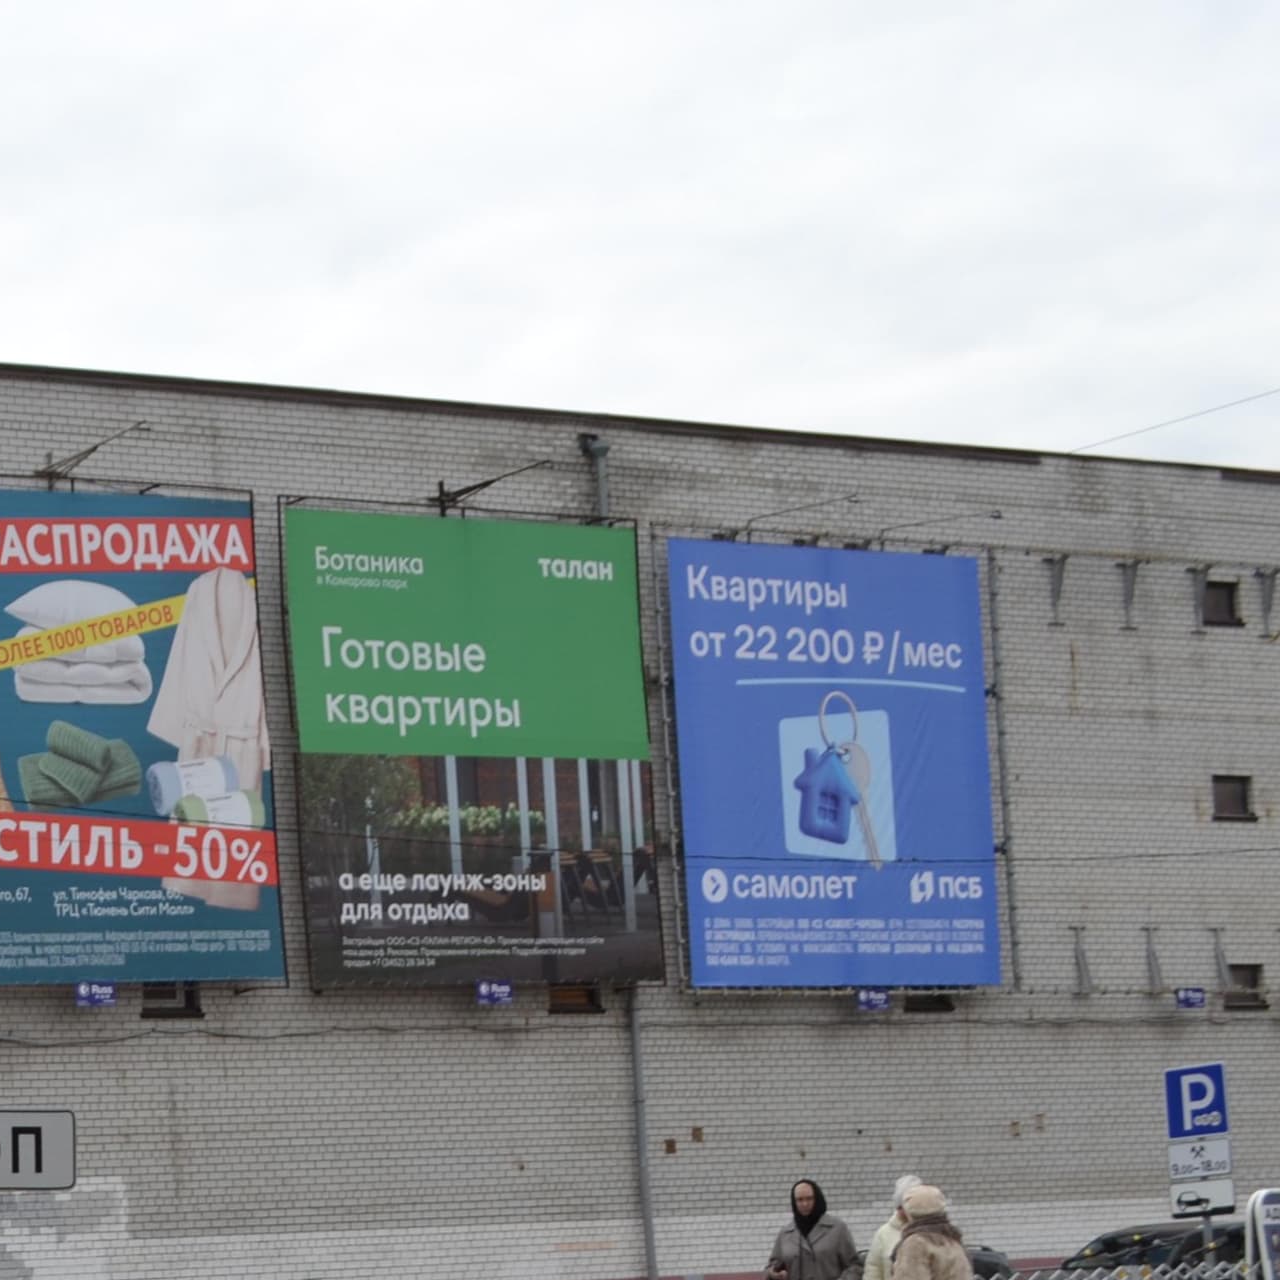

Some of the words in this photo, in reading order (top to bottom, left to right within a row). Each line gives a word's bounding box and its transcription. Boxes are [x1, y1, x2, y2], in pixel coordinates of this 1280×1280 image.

[314, 546, 424, 575] Ботаника
[538, 558, 614, 581] талан
[686, 564, 848, 615] Квартиры
[47, 629, 85, 654] 1000
[88, 604, 174, 640] ТОВАРОВ
[321, 625, 486, 672] Готовые
[690, 630, 726, 658] от
[733, 624, 779, 660] 22
[786, 626, 855, 664] 200
[325, 693, 522, 738] квартиры
[153, 825, 269, 883] -50%
[339, 873, 354, 890] а
[359, 873, 406, 895] еще
[411, 873, 546, 897] лаунж-зоны
[733, 874, 857, 899] самолет
[55, 904, 80, 917] ТРЦ
[341, 902, 382, 925] для
[388, 902, 470, 925] отдыха
[1180, 1073, 1216, 1131] P
